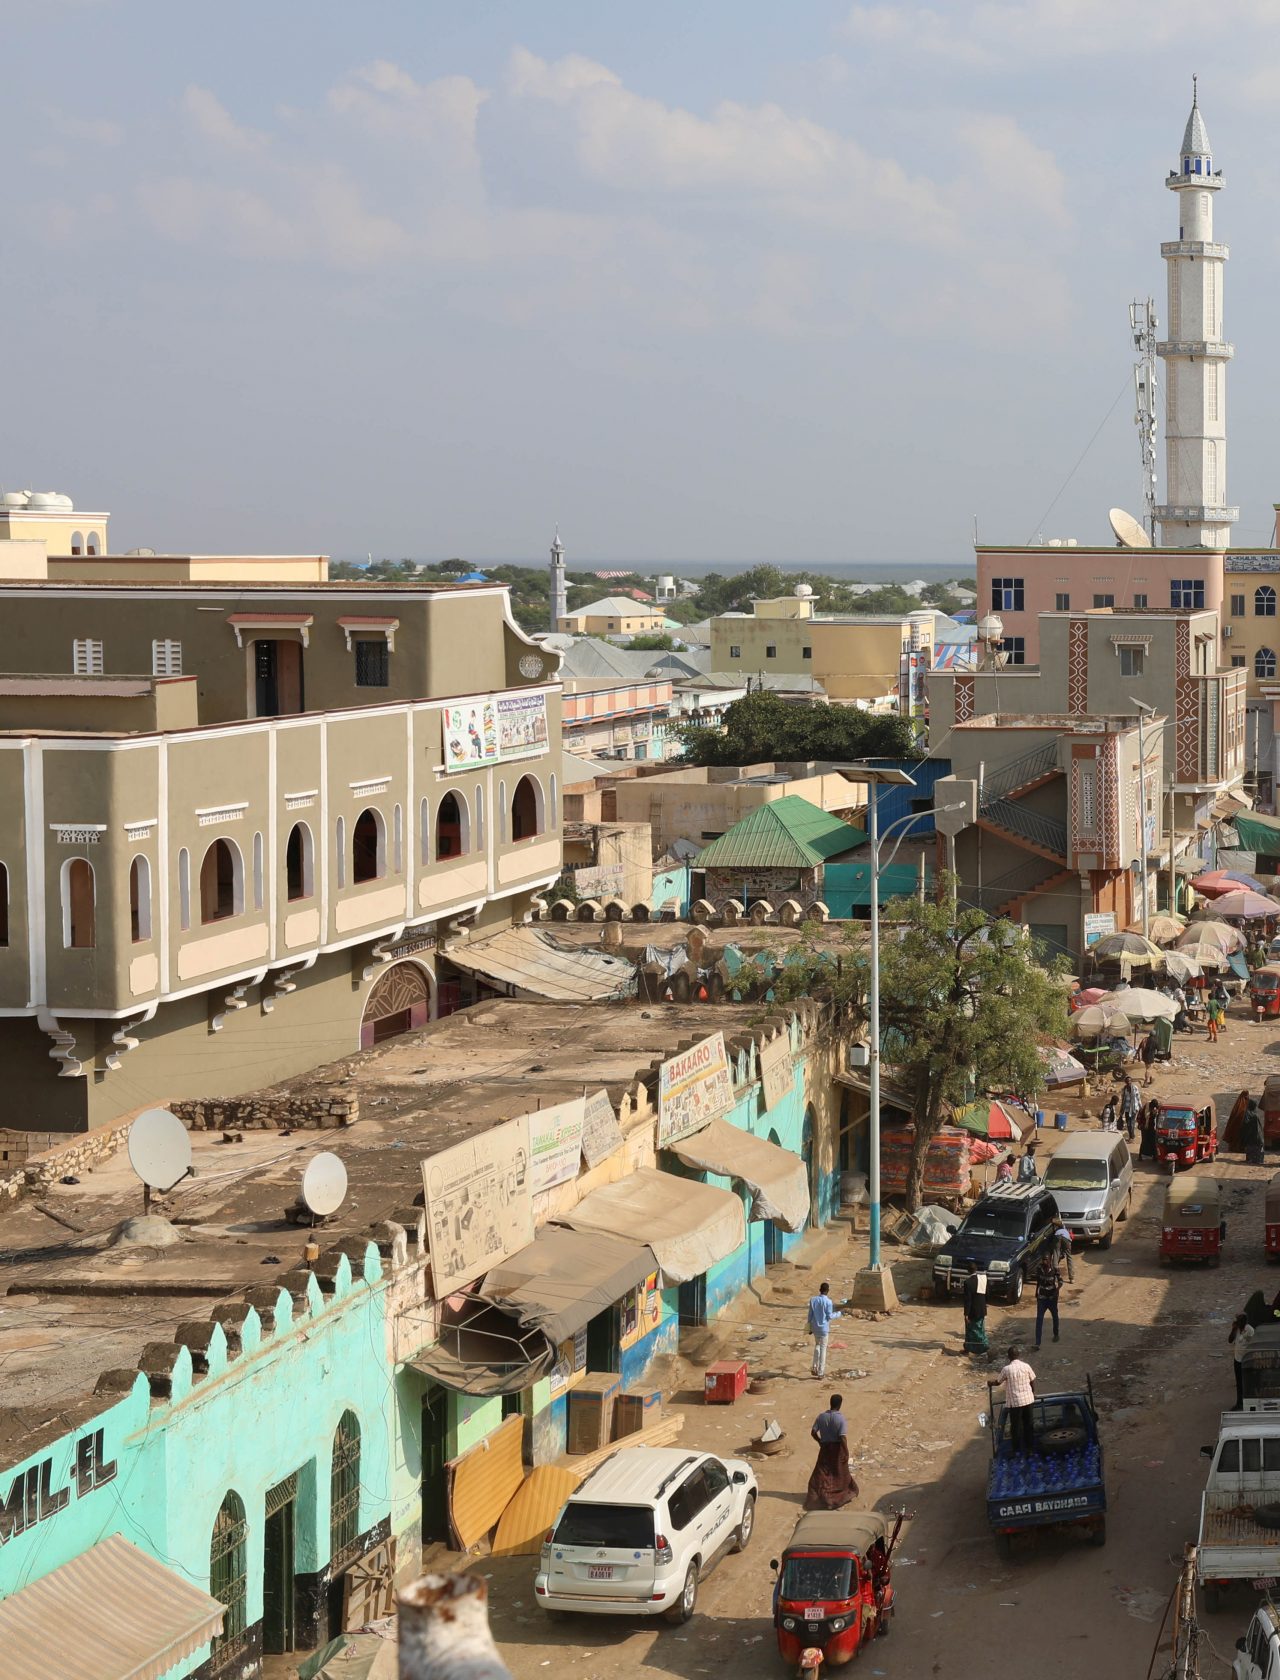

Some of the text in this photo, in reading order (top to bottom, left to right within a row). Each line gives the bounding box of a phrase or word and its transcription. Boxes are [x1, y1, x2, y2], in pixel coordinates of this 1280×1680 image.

[669, 1045, 710, 1082] BAKAARO
[701, 1507, 731, 1544] PRADO
[1000, 1503, 1032, 1517] CAAFI
